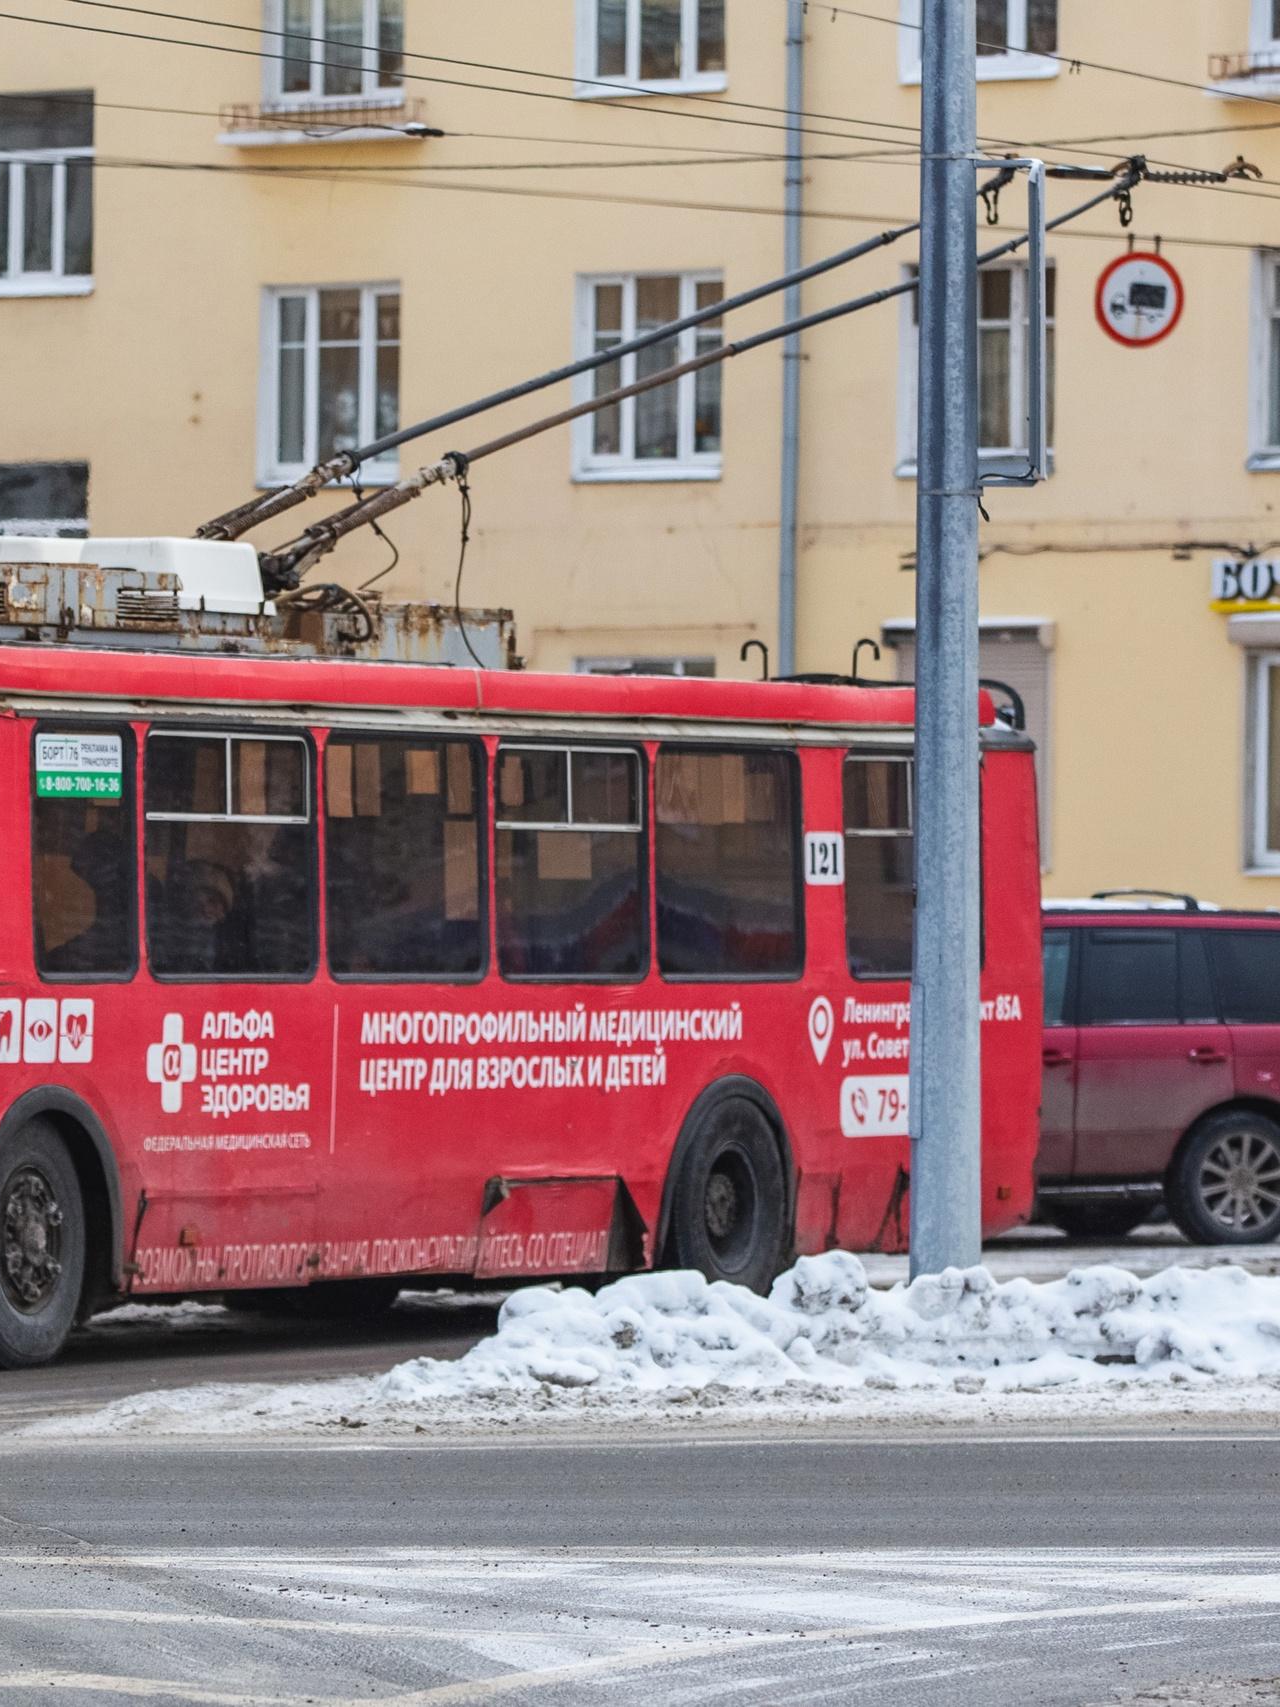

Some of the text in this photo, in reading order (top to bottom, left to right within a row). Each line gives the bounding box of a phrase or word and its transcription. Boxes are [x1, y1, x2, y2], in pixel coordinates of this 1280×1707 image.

[810, 842, 838, 875] 121
[201, 1008, 275, 1042] АЛЬФА
[360, 1001, 742, 1047] МНОГОПРОФИЛЬНЫЙ МЕДИЦИНСКИЙ
[843, 996, 910, 1030] Ленингра
[201, 1047, 269, 1082] ЦЕНТР
[842, 1032, 910, 1068] ул. Совет
[360, 1046, 667, 1097] ЦЕНТР ДЛЯ ВЗРОСЛЫХ И ДЕТЕЙ
[200, 1083, 310, 1119] ЗДОРОВЬЯ
[878, 1087, 907, 1122] 79-
[143, 1132, 311, 1153] ФЕДЕРАЛЬНАЯ МЕДИЦИНСКАЯ СЕТЬ
